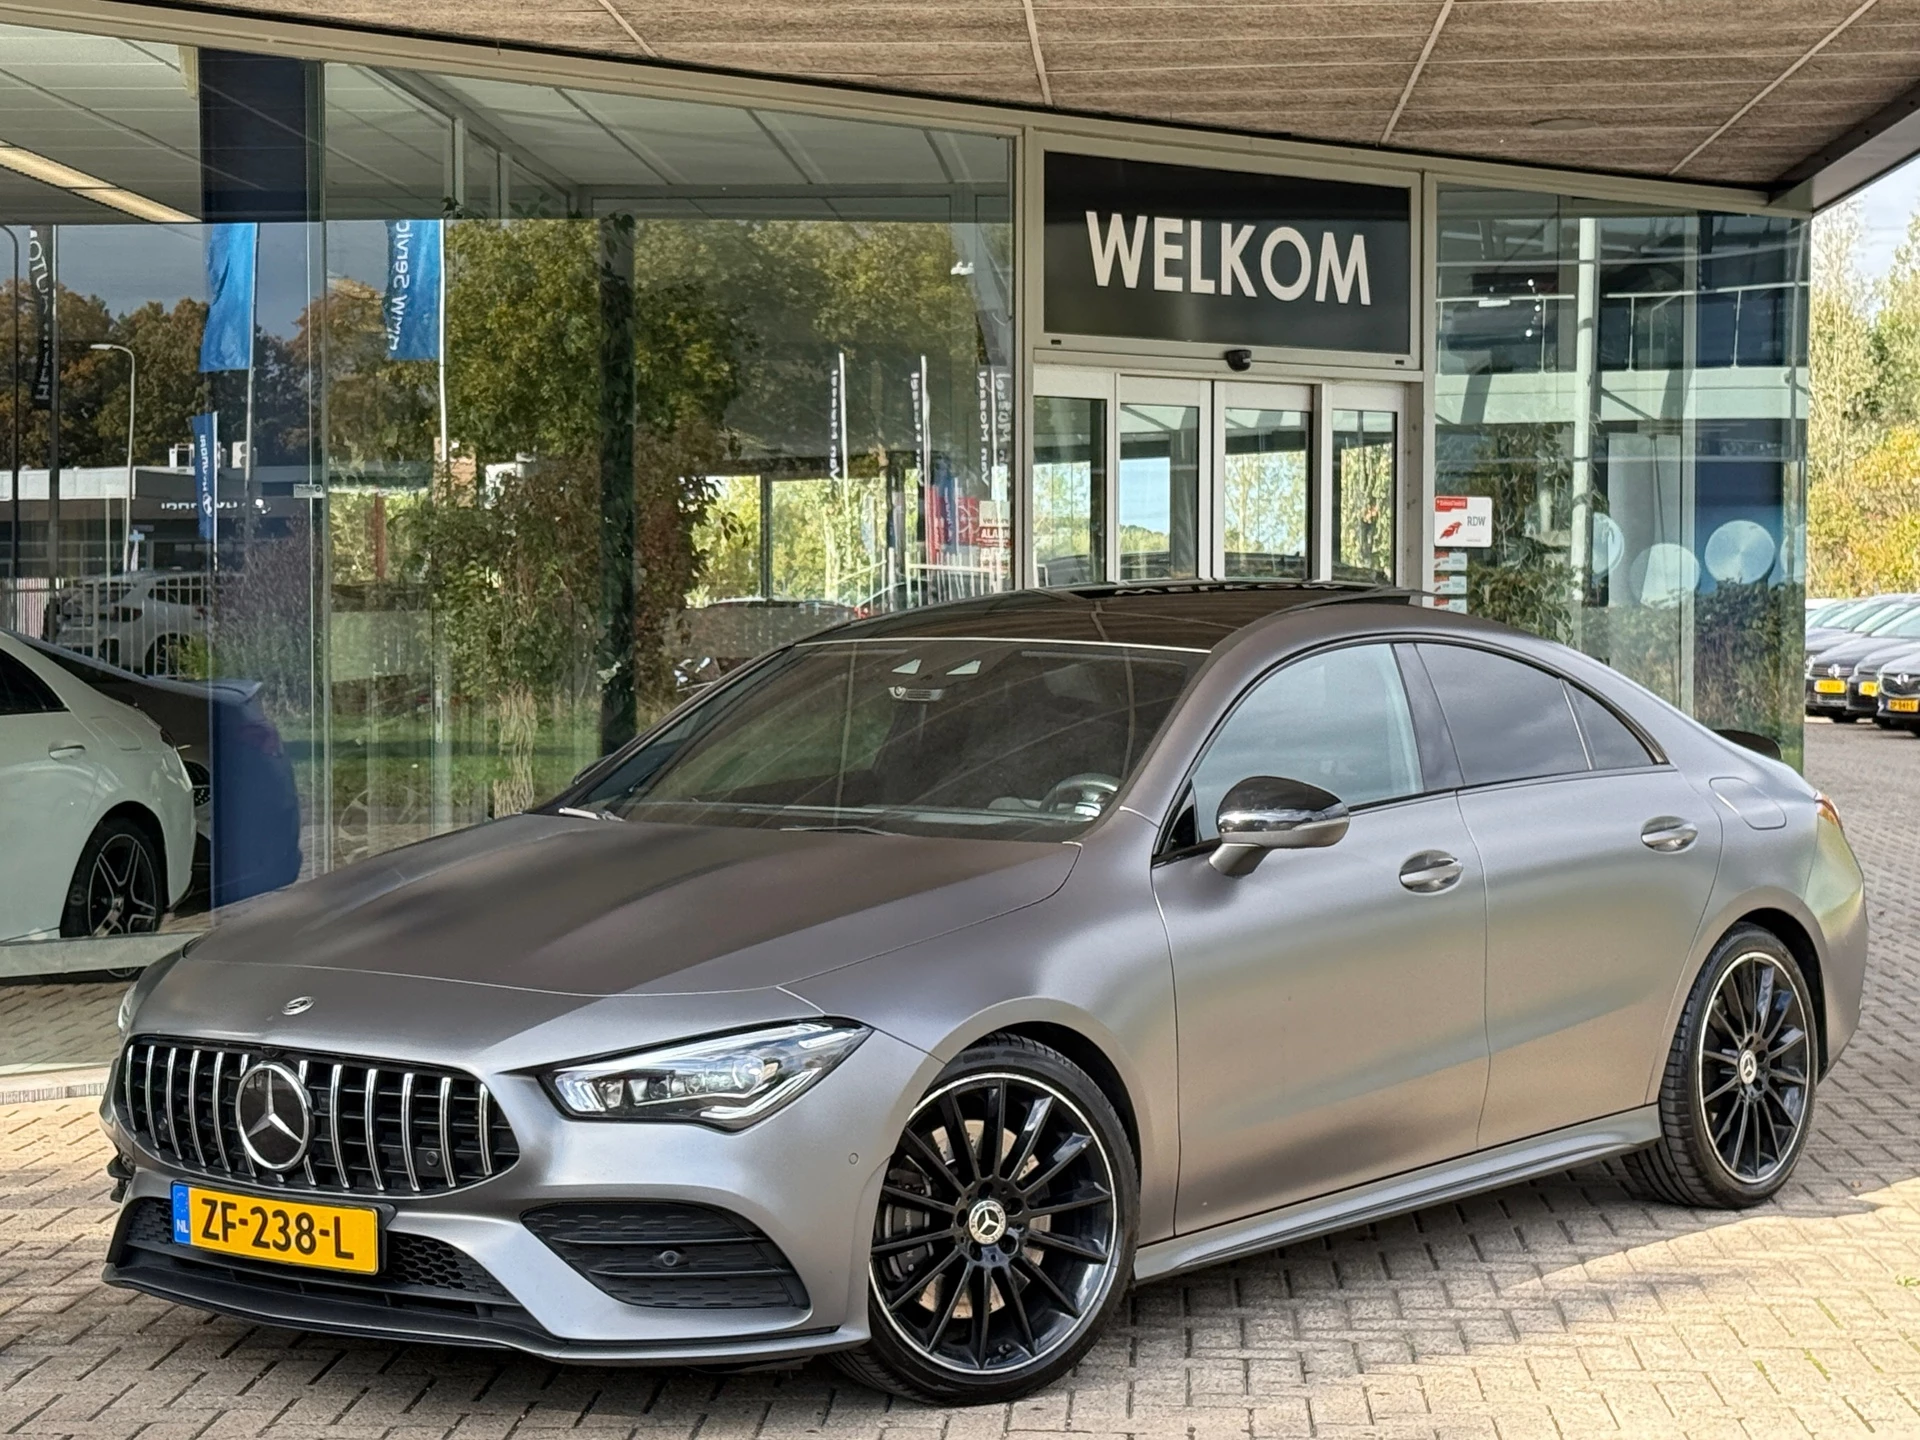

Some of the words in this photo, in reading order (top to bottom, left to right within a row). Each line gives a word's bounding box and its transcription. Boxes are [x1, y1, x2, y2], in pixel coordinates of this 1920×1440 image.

[1085, 211, 1371, 305] WELKOM
[1467, 515, 1486, 527] RDW
[176, 1219, 189, 1233] NL
[201, 1198, 354, 1260] ZF-238-L
